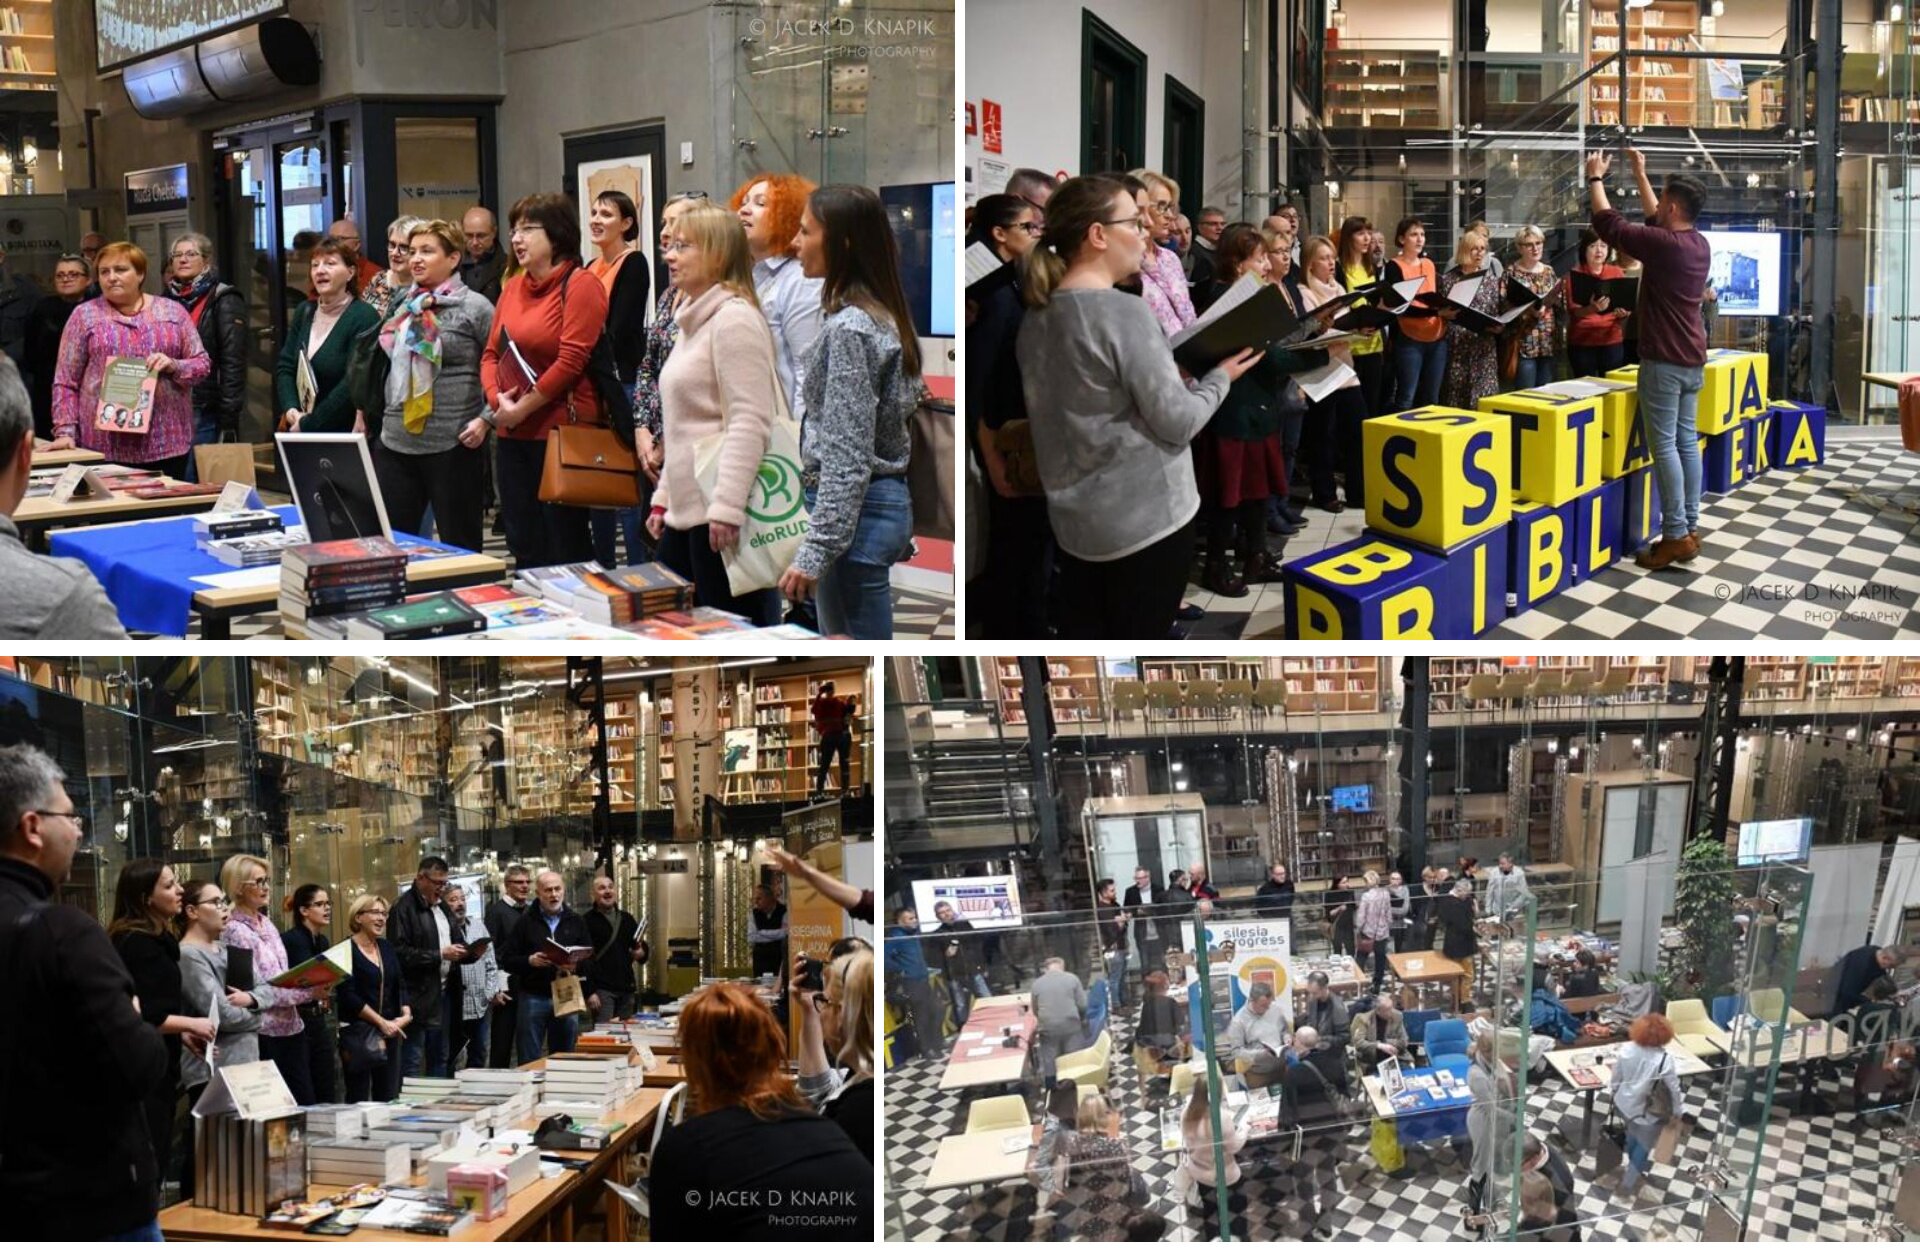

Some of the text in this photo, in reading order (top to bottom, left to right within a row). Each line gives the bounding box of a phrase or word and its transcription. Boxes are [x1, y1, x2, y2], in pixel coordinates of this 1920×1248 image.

[750, 519, 812, 549] ekoRUD
[1223, 926, 1268, 938] silesia
[1233, 936, 1285, 948] rogress
